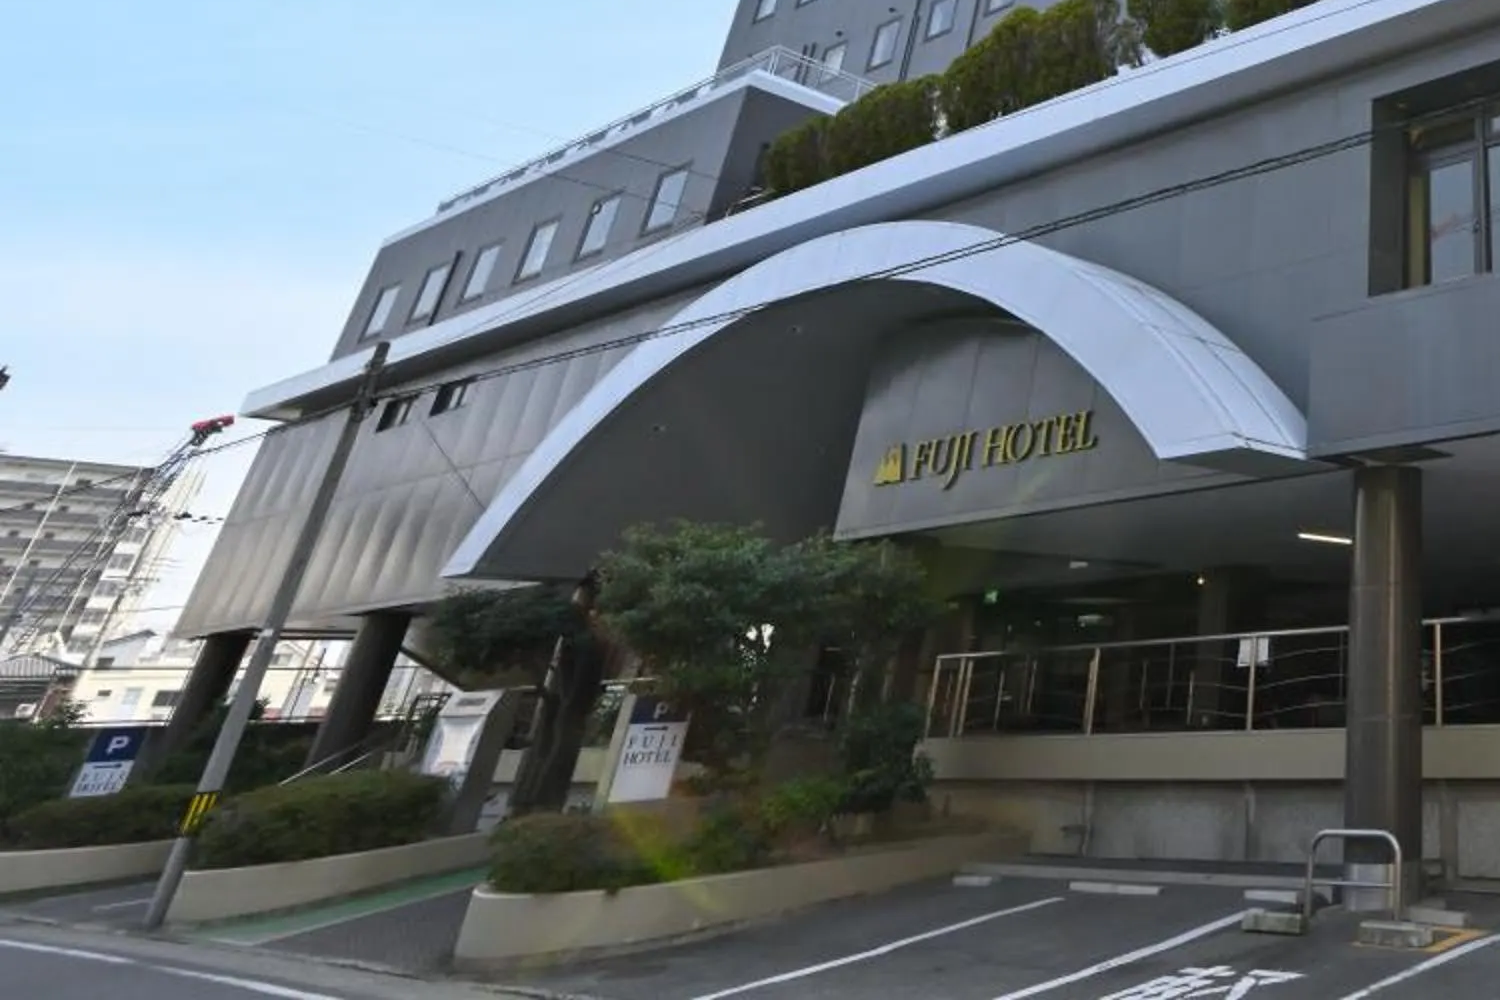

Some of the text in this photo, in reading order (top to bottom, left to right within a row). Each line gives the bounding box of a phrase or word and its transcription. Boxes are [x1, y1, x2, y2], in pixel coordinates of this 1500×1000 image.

[909, 410, 1098, 490] FUJI HOTEL
[653, 702, 668, 719] P
[106, 735, 130, 755] P
